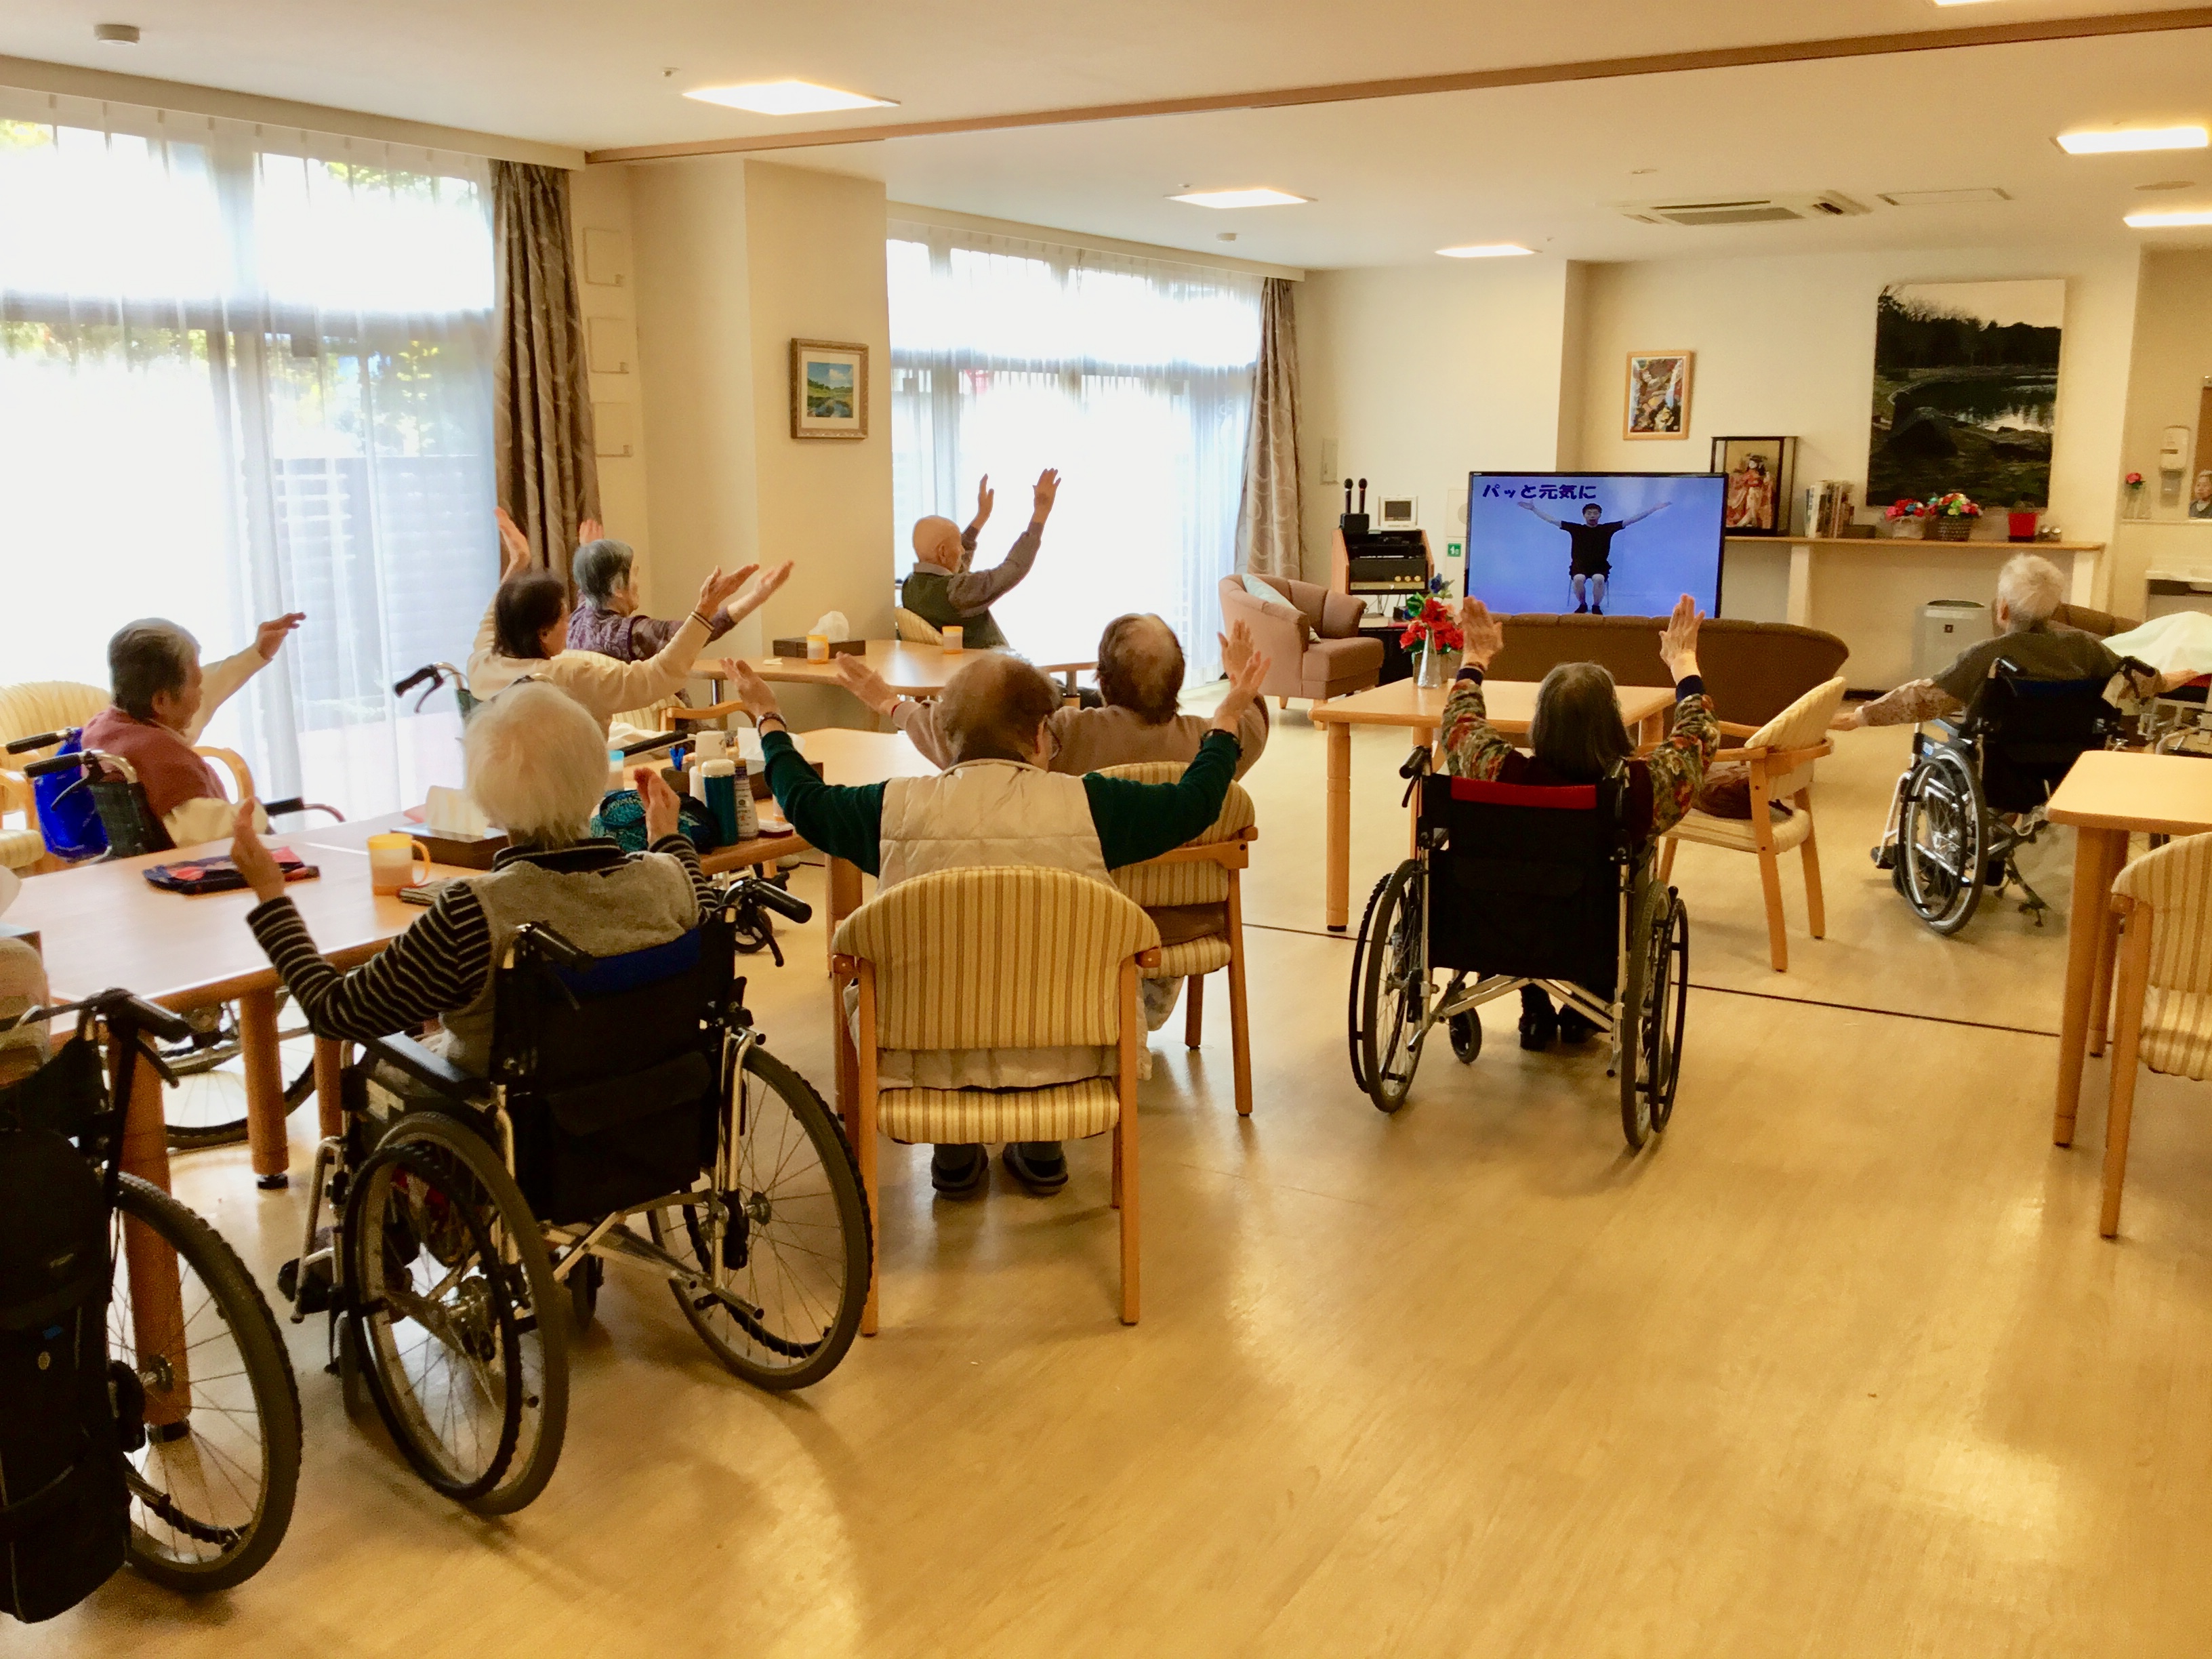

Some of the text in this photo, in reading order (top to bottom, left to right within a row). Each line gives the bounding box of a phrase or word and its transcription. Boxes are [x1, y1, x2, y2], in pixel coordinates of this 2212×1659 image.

[1482, 484, 1597, 500] パッと元気に
